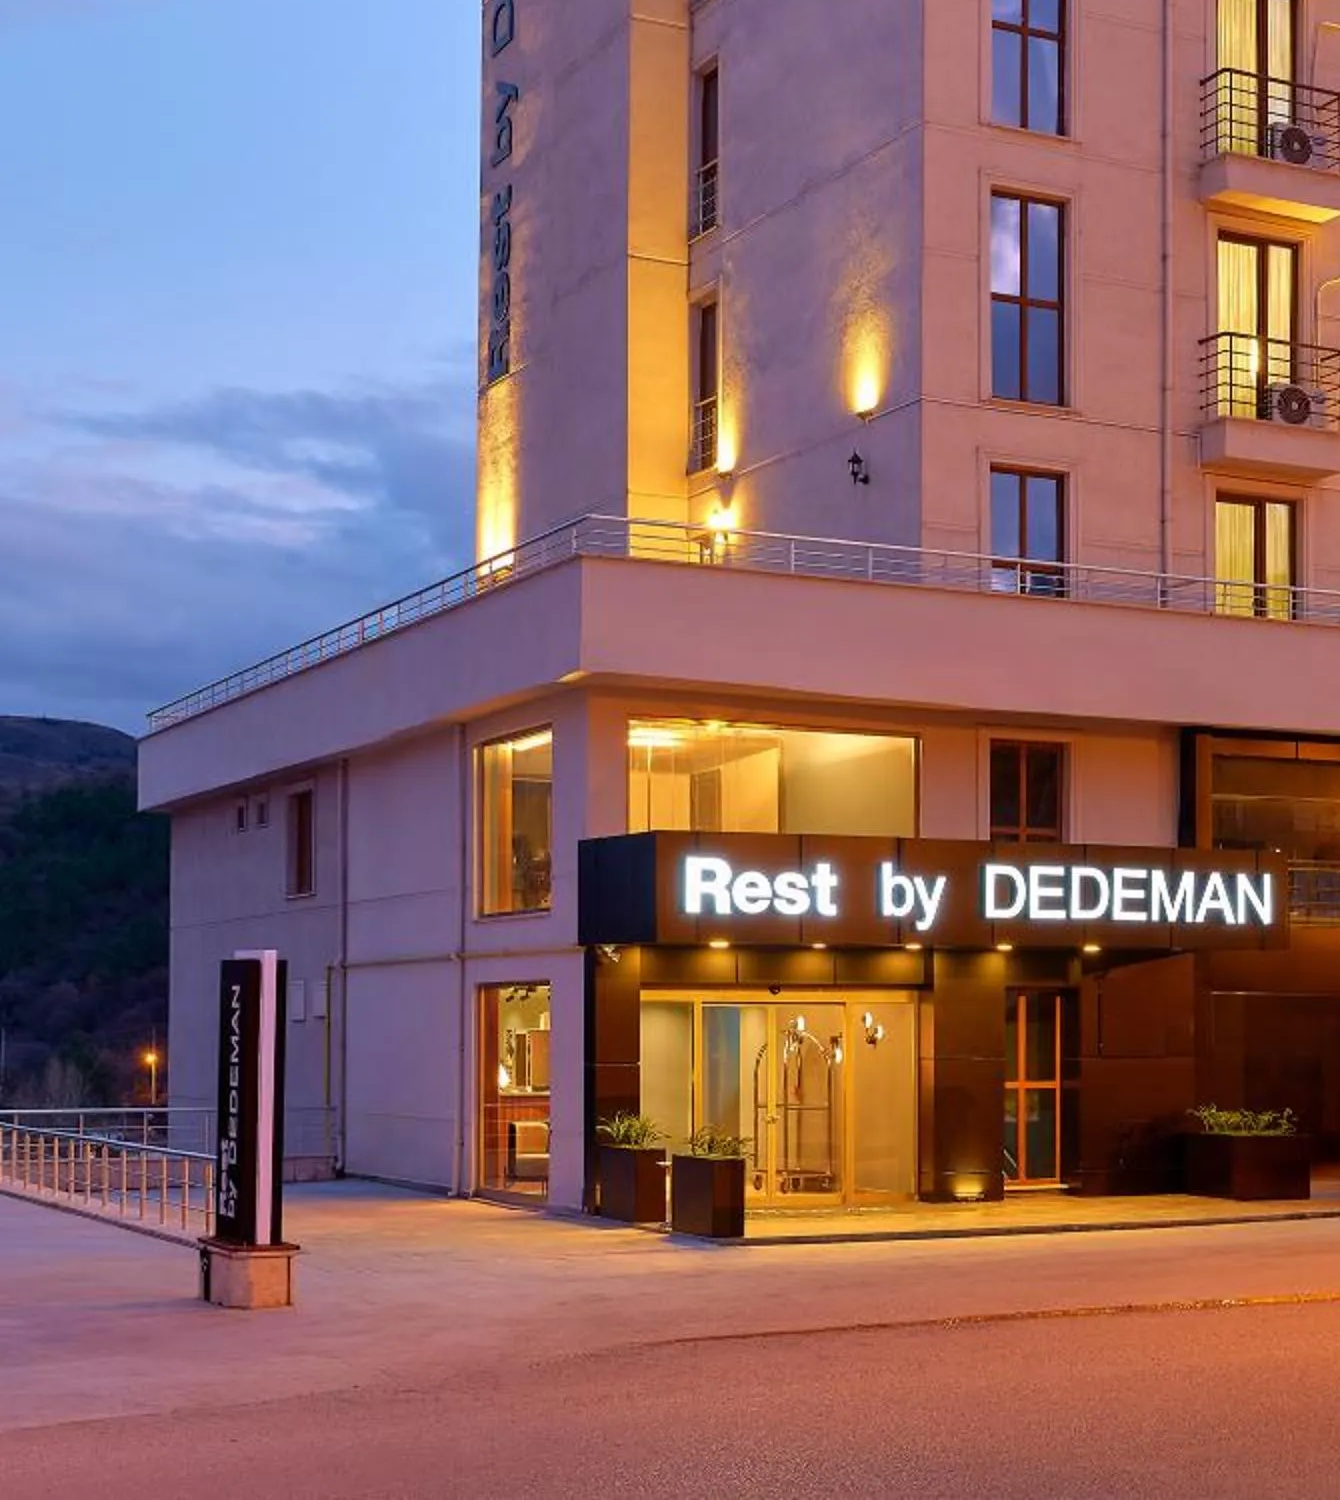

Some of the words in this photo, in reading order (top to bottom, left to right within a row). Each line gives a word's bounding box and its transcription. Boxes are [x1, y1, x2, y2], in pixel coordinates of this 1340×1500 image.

[492, 80, 518, 167] by
[489, 182, 511, 383] Rest
[684, 855, 838, 917] Rest
[880, 861, 946, 930] by
[983, 864, 1274, 926] DEDEMAN
[227, 984, 241, 1165] DEDEMAN
